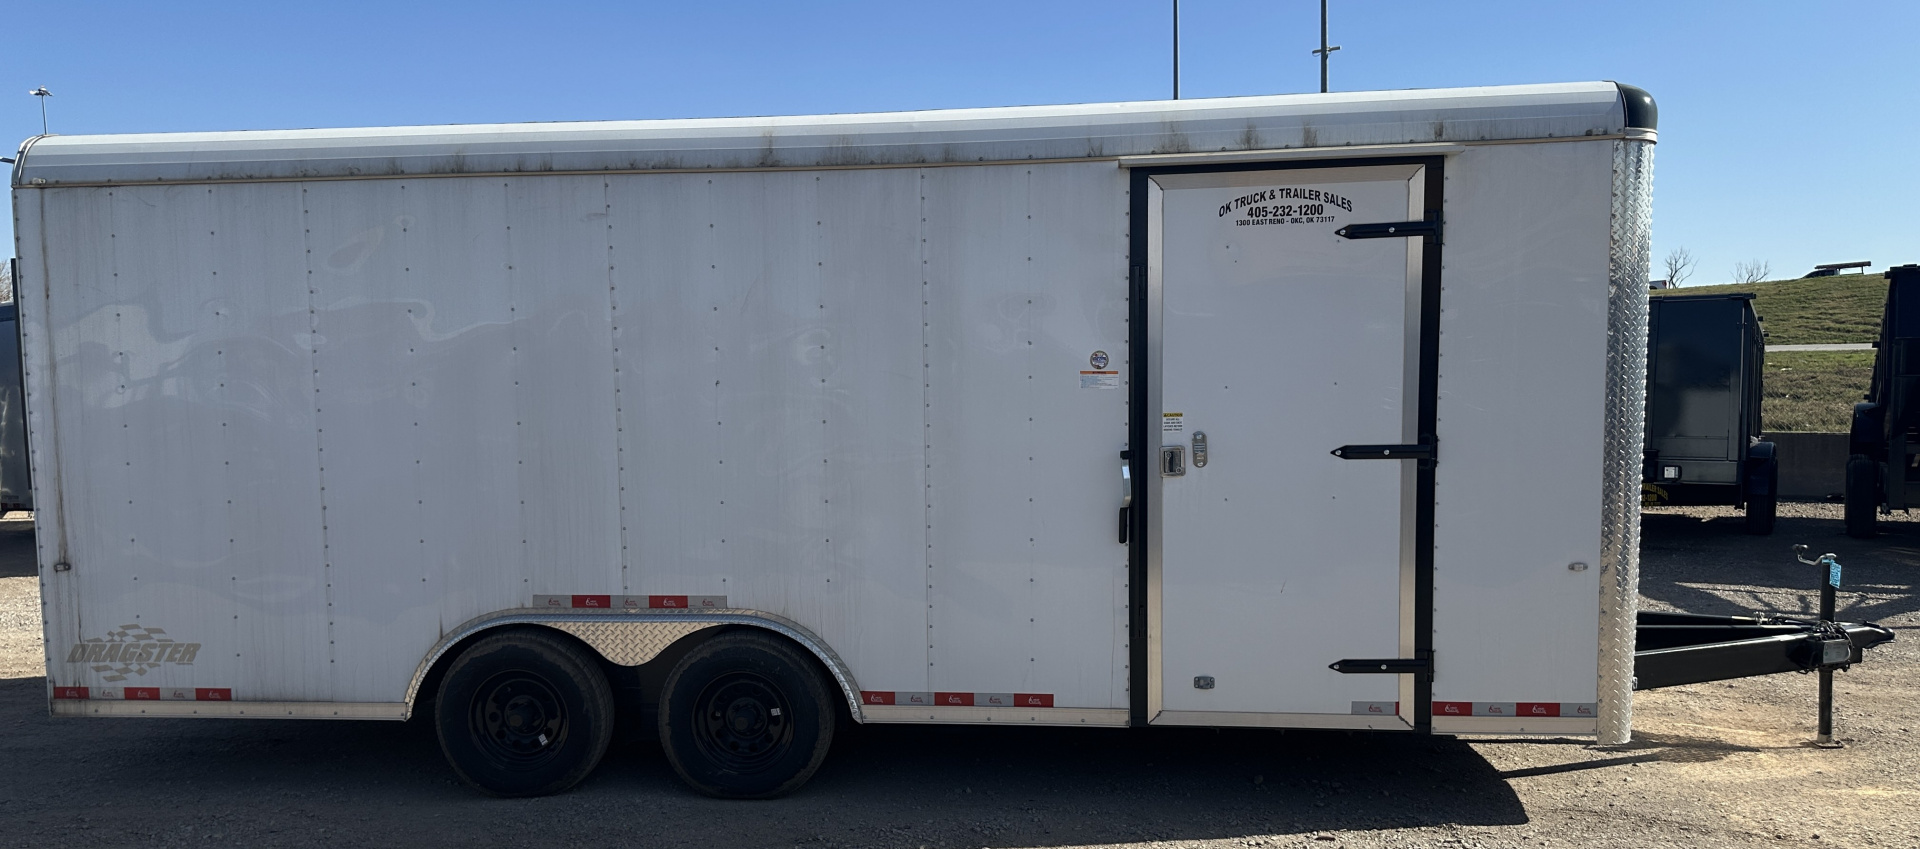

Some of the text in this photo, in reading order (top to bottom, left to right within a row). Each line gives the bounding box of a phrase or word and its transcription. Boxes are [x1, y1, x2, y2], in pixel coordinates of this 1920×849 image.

[1218, 187, 1353, 218] OK TRUCK & TRAILER SALES
[1247, 203, 1324, 219] 405-232-1200
[1235, 219, 1251, 227] 1300
[1251, 218, 1268, 226] EAST
[1268, 218, 1285, 226] RENO
[1290, 216, 1305, 225] OKC,
[1305, 216, 1315, 224] OK
[1316, 215, 1335, 224] 73117
[66, 643, 202, 664] DRAGSTER
